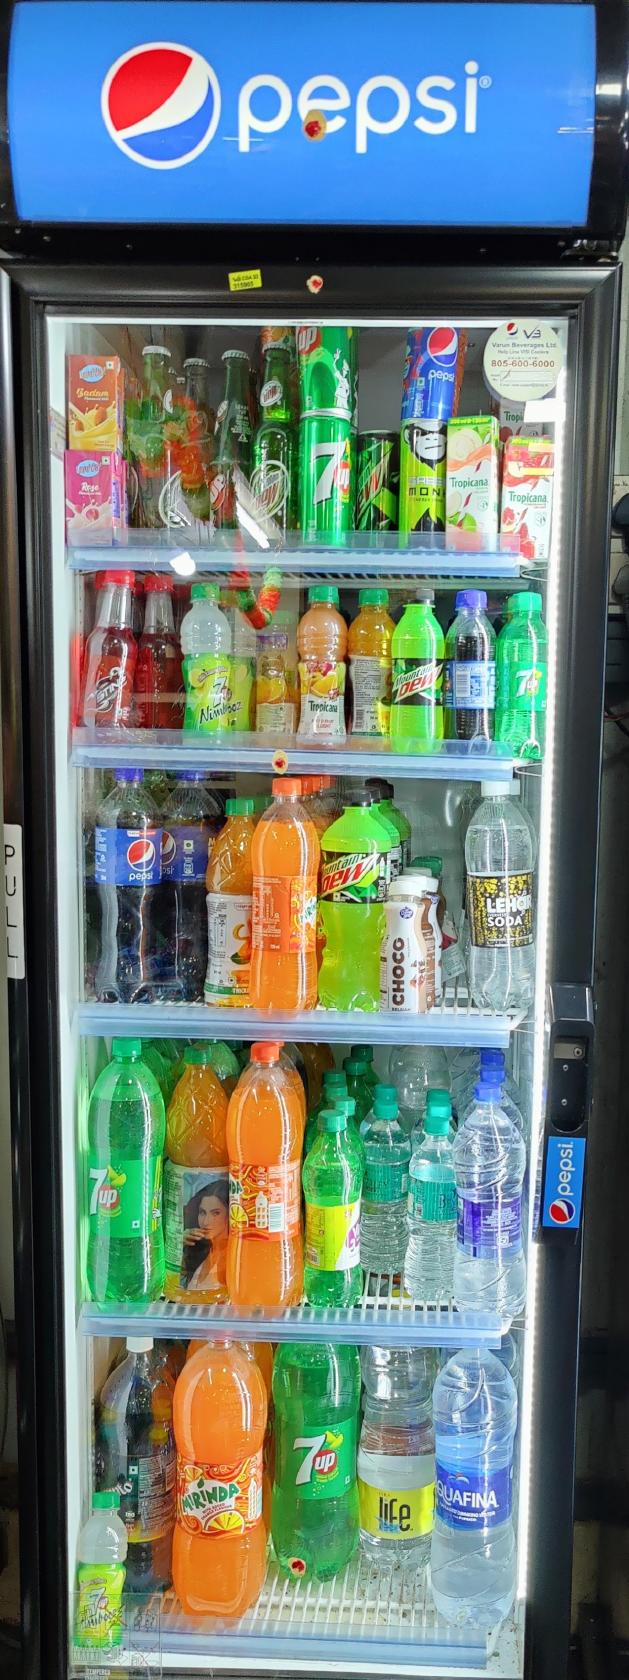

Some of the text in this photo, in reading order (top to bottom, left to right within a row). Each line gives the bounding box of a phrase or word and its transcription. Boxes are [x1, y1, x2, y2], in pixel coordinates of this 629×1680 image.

[238, 61, 478, 154] pepsi
[491, 360, 555, 368] 805-600-6000
[76, 388, 109, 398] Badam
[81, 482, 99, 492] Rose
[449, 477, 489, 488] Tropicana
[508, 491, 547, 504] Tropicana
[308, 700, 338, 713] Tropicana
[128, 871, 154, 882] pepsi
[5, 844, 19, 958] PULL
[487, 916, 523, 927] SODA
[557, 1142, 576, 1196] pepsi
[182, 1483, 240, 1513] MIRINDA
[437, 1480, 498, 1508] QUAFINA
[379, 1496, 411, 1532] life
